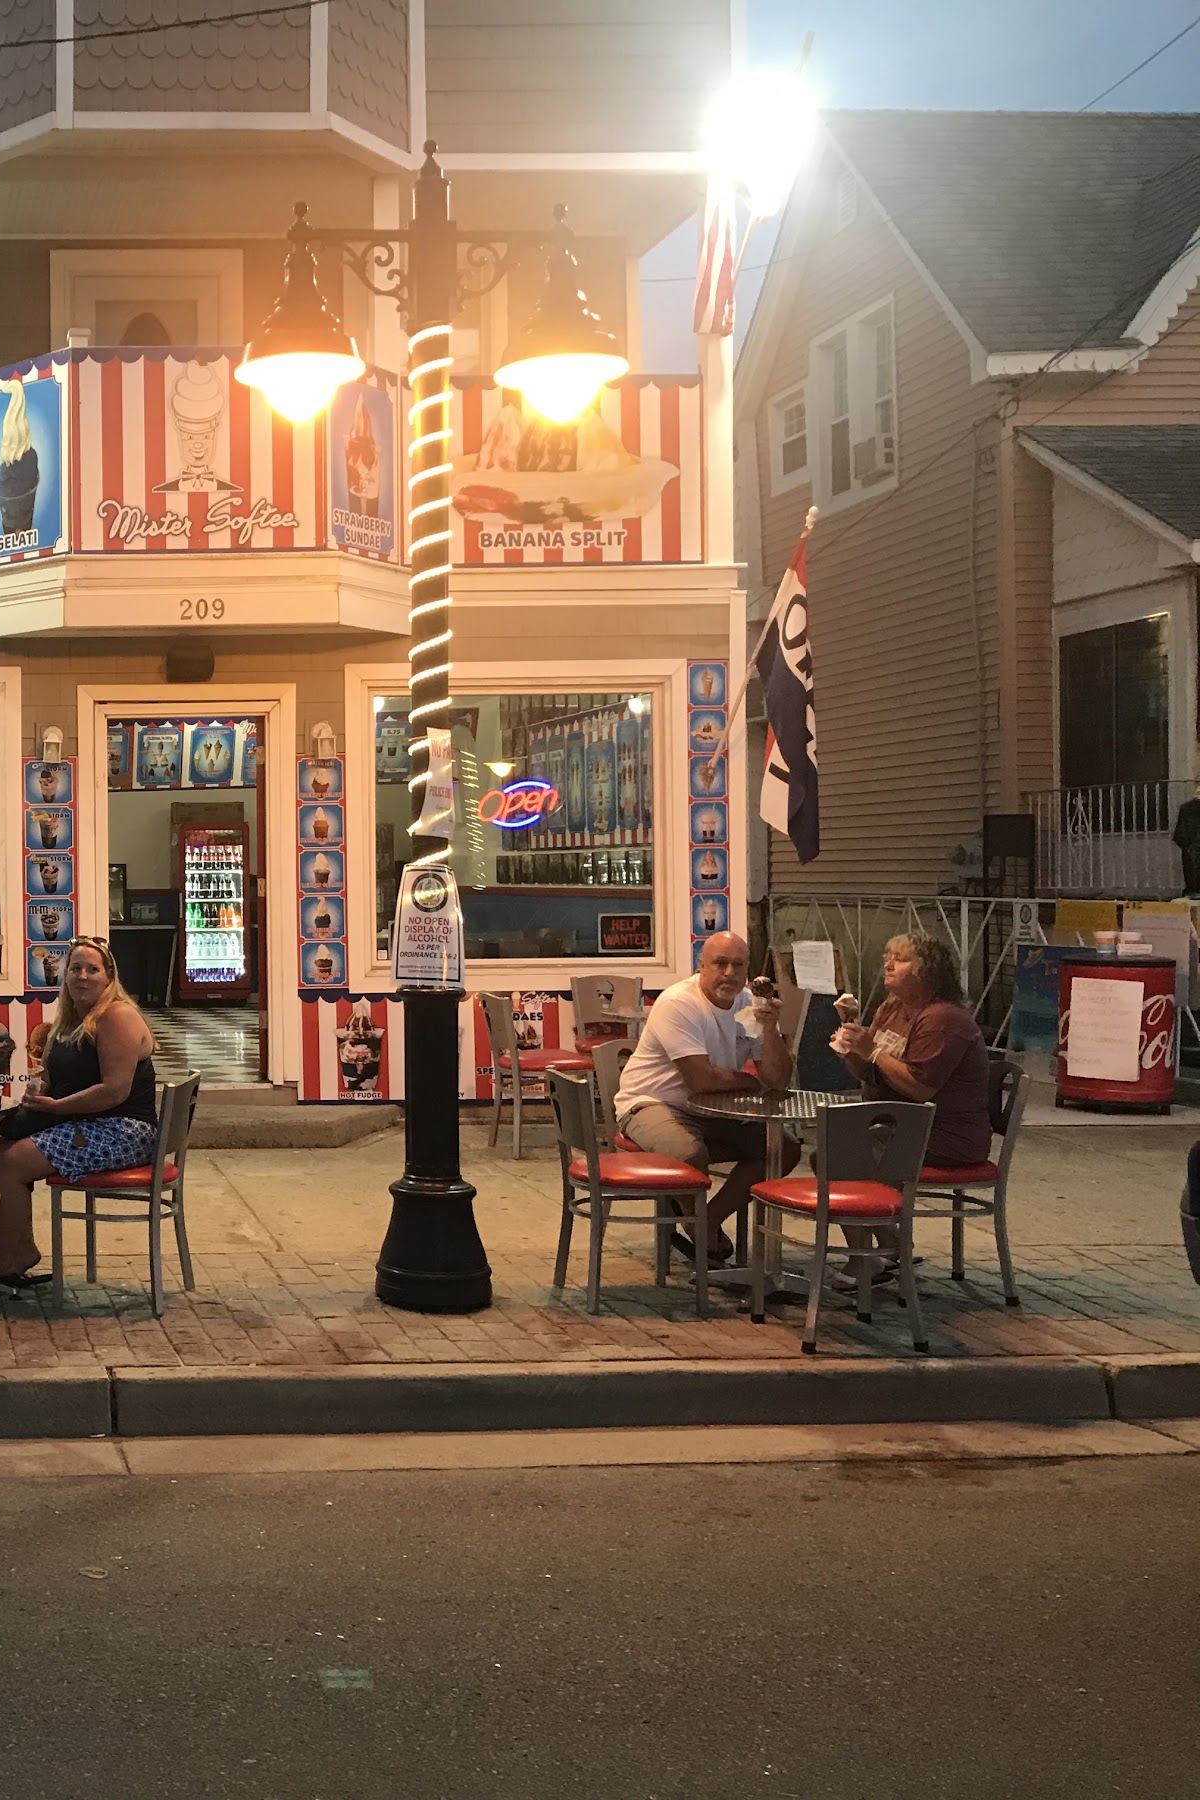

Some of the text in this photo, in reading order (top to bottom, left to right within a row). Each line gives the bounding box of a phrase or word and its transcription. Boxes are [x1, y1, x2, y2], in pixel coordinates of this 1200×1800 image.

[98, 496, 300, 545] Mister Softee
[333, 509, 391, 536] STRAWBERRY
[345, 528, 381, 549] SUNDAE
[480, 530, 626, 548] BANANA SPLIT
[179, 598, 226, 620] 209
[476, 788, 559, 822] Open
[408, 916, 450, 926] NO OPEN
[611, 918, 641, 931] HELP
[404, 925, 454, 935] DISPLAY OF
[407, 934, 450, 944] ALCOHOL
[603, 933, 650, 946] WANTED
[400, 951, 438, 959] ORDINANCE
[512, 1012, 544, 1021] DAES
